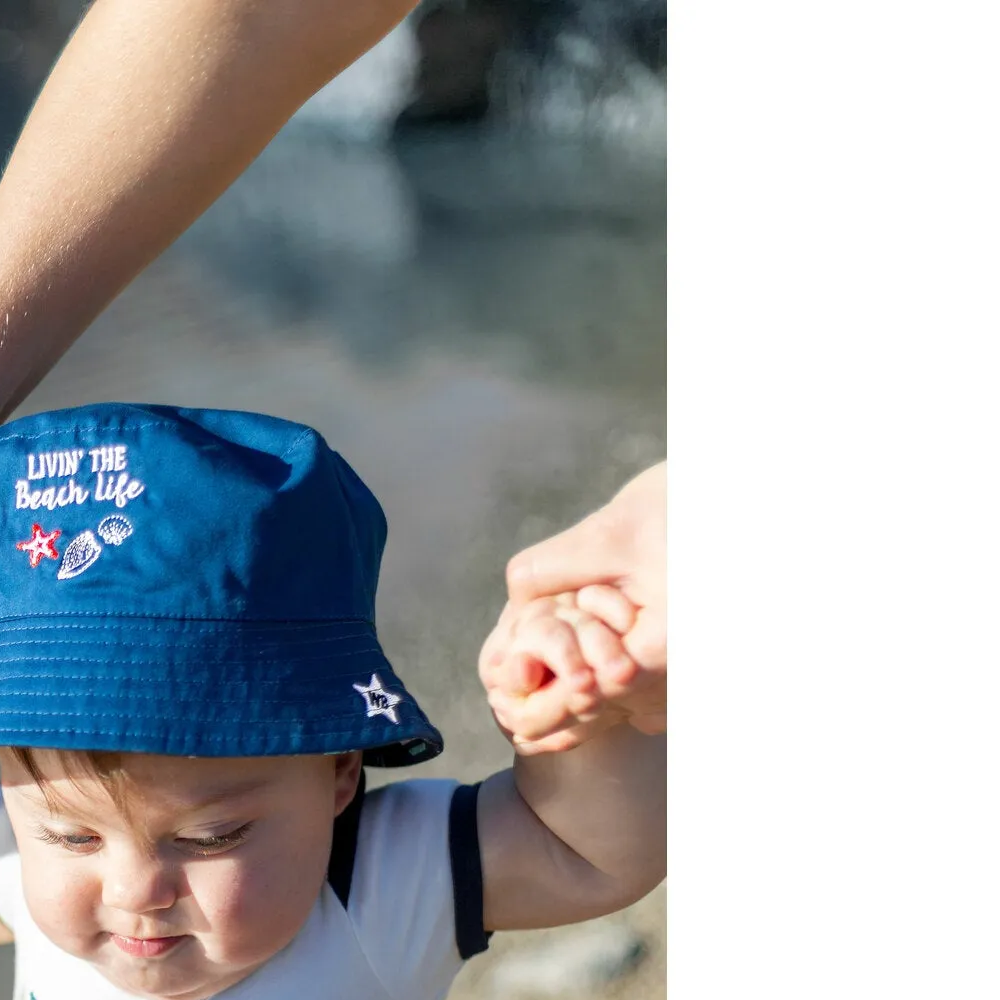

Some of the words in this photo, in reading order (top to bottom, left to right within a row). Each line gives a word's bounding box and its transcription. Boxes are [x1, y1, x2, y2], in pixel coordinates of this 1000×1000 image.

[27, 450, 84, 480] LIVIN'
[89, 445, 127, 473] THE
[15, 479, 89, 510] Beach
